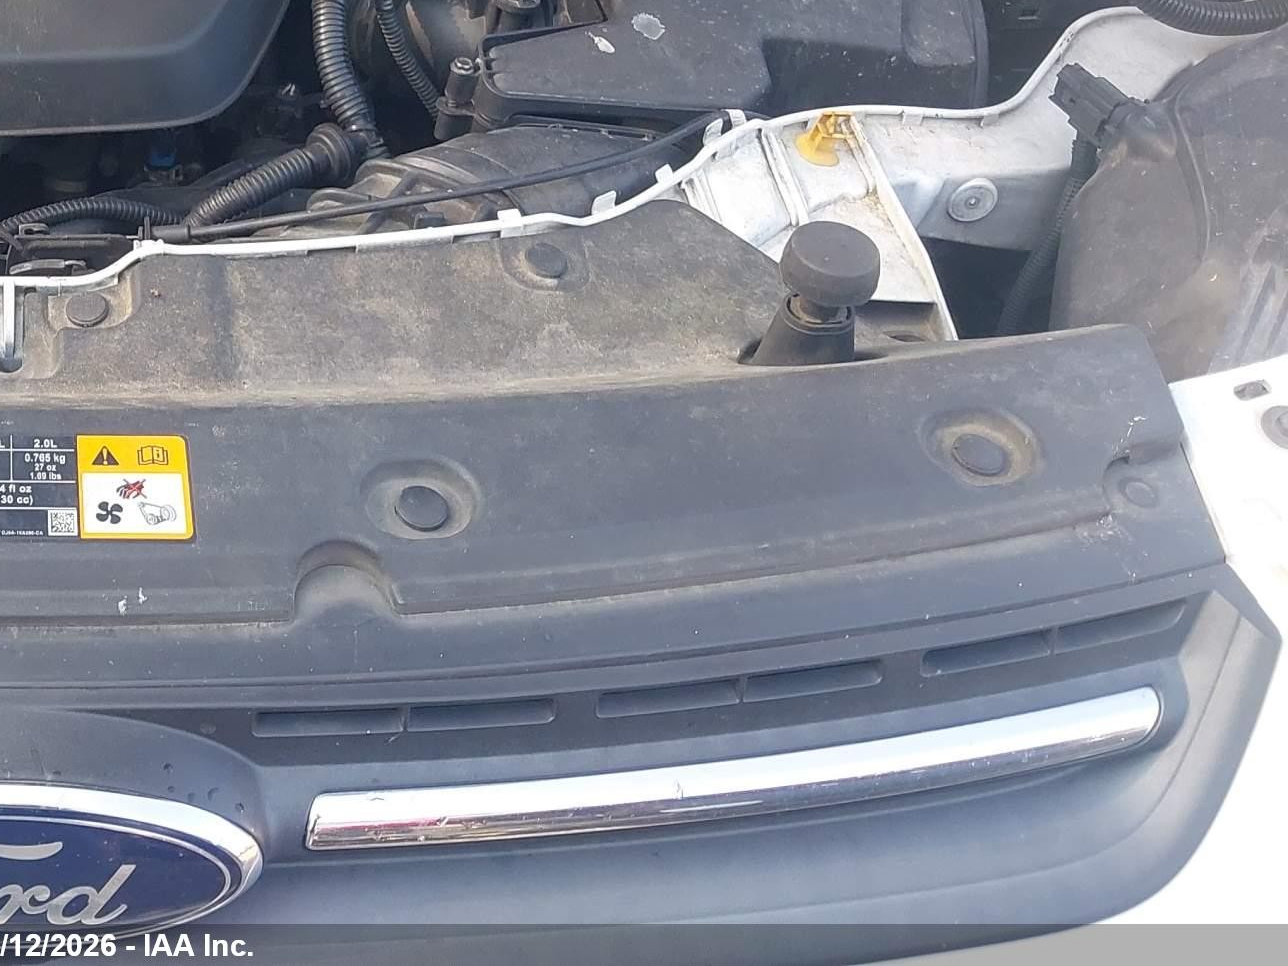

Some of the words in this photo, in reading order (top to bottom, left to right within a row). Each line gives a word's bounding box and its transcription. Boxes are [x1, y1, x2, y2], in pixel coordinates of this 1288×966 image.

[33, 438, 58, 448] 2.0L
[53, 452, 66, 464] kg
[34, 463, 45, 471] 27
[46, 464, 57, 472] oz
[48, 472, 62, 480] lbs
[8, 483, 16, 494] fl
[18, 485, 33, 494] oz
[16, 495, 34, 506] cc)
